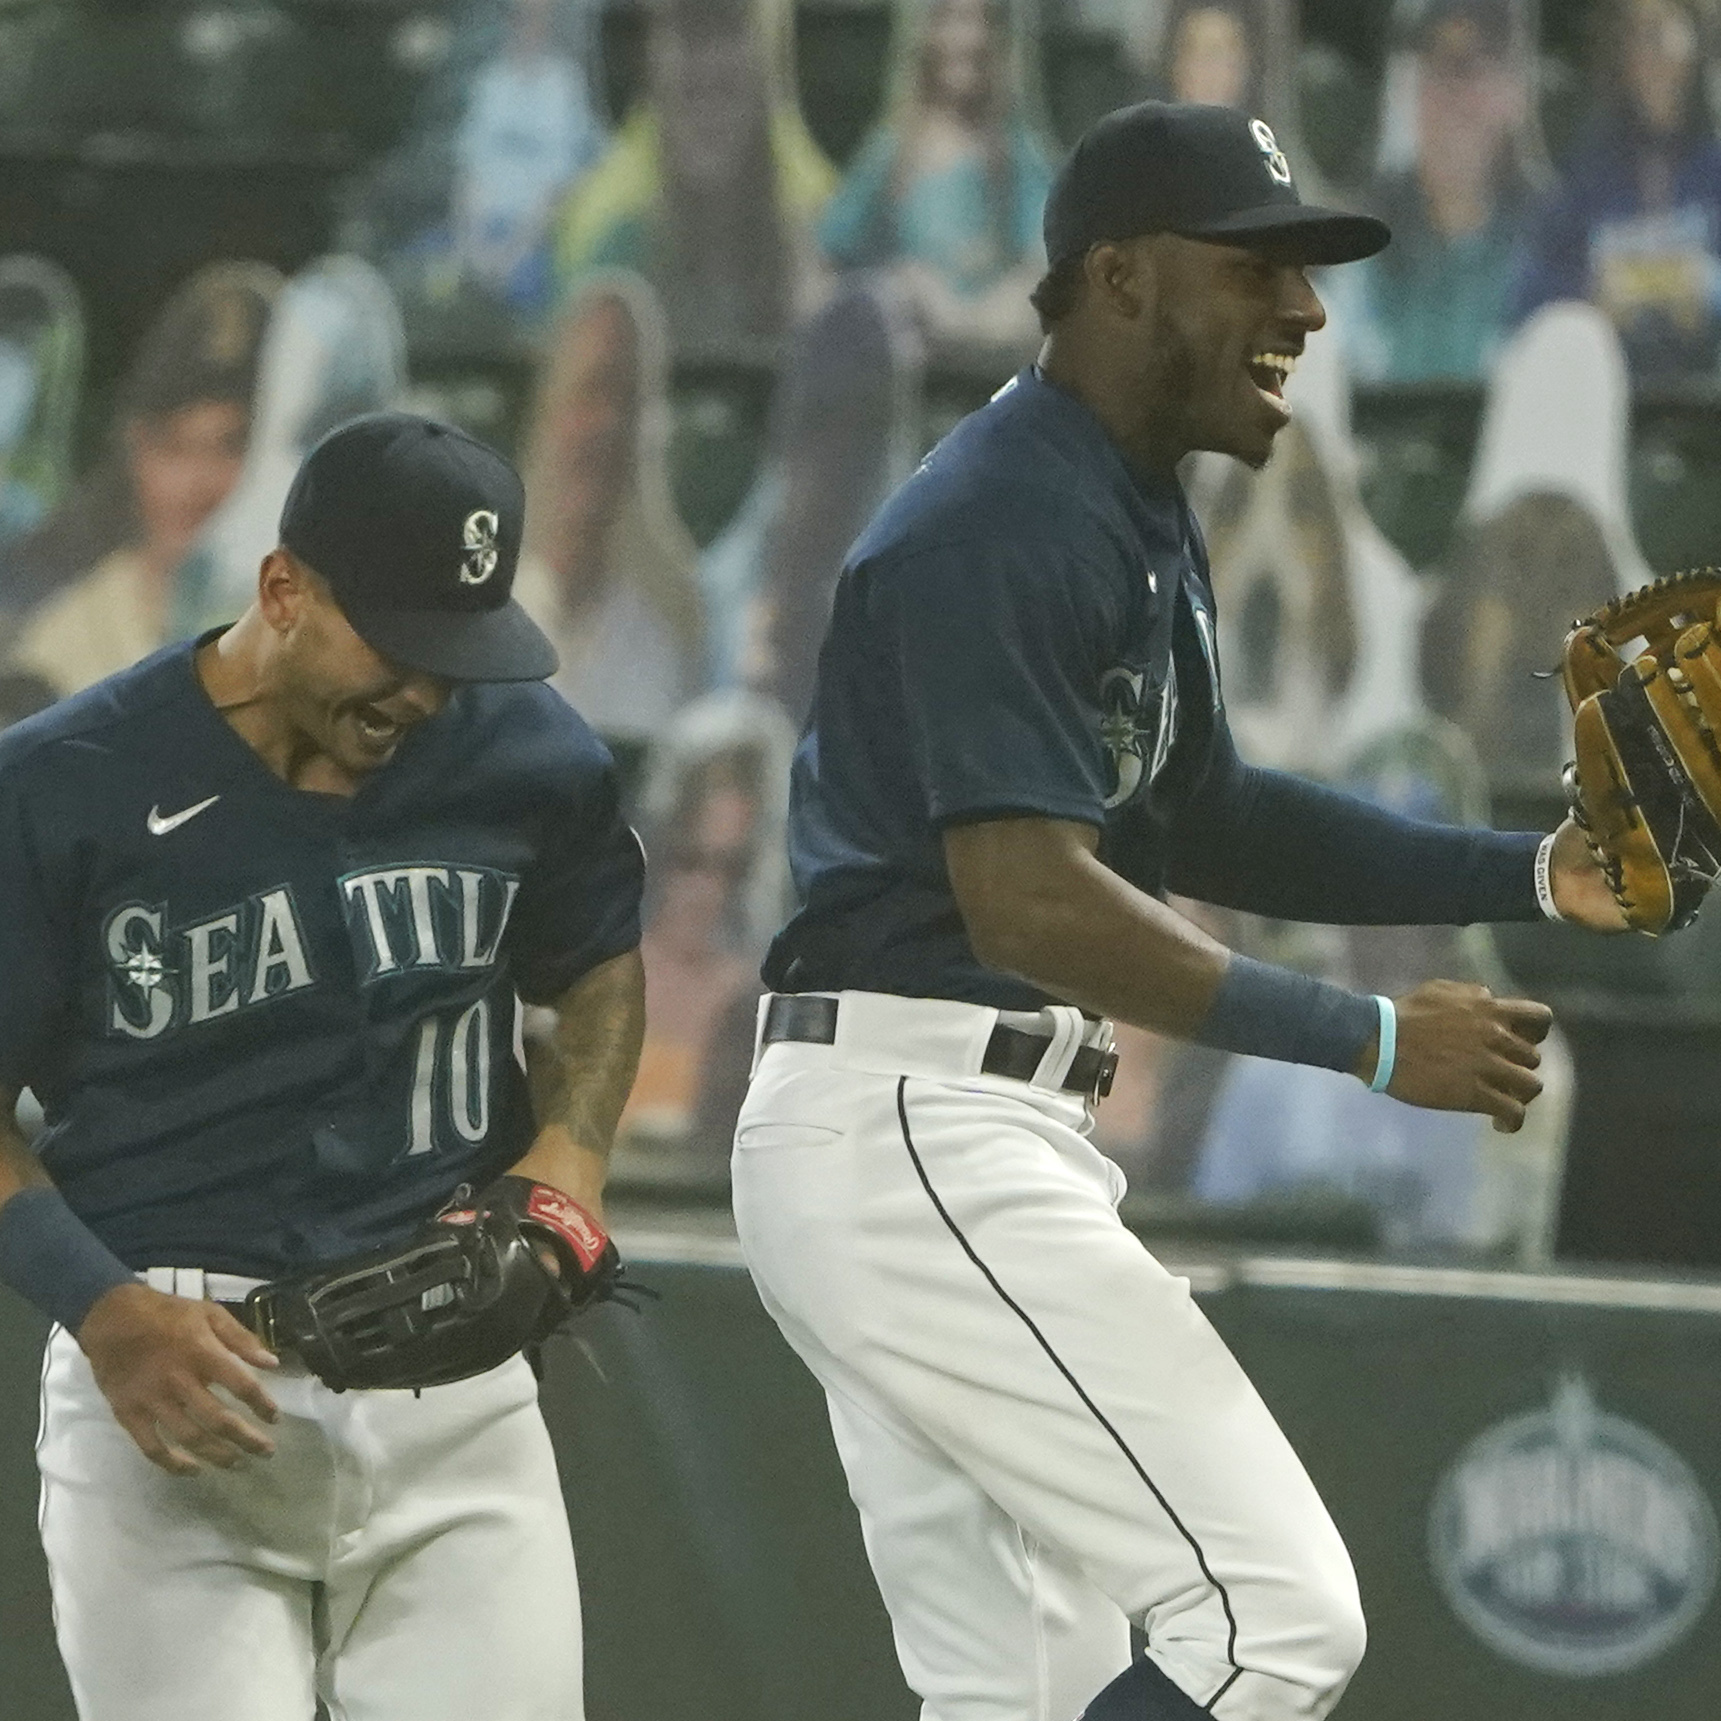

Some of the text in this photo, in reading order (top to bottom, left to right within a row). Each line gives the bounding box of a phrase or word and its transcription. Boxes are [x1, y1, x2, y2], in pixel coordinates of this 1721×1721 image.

[460, 510, 499, 585] S
[1537, 867, 1549, 902] GIVEN
[106, 866, 520, 1040] SEATTL
[410, 999, 491, 1156] 10
